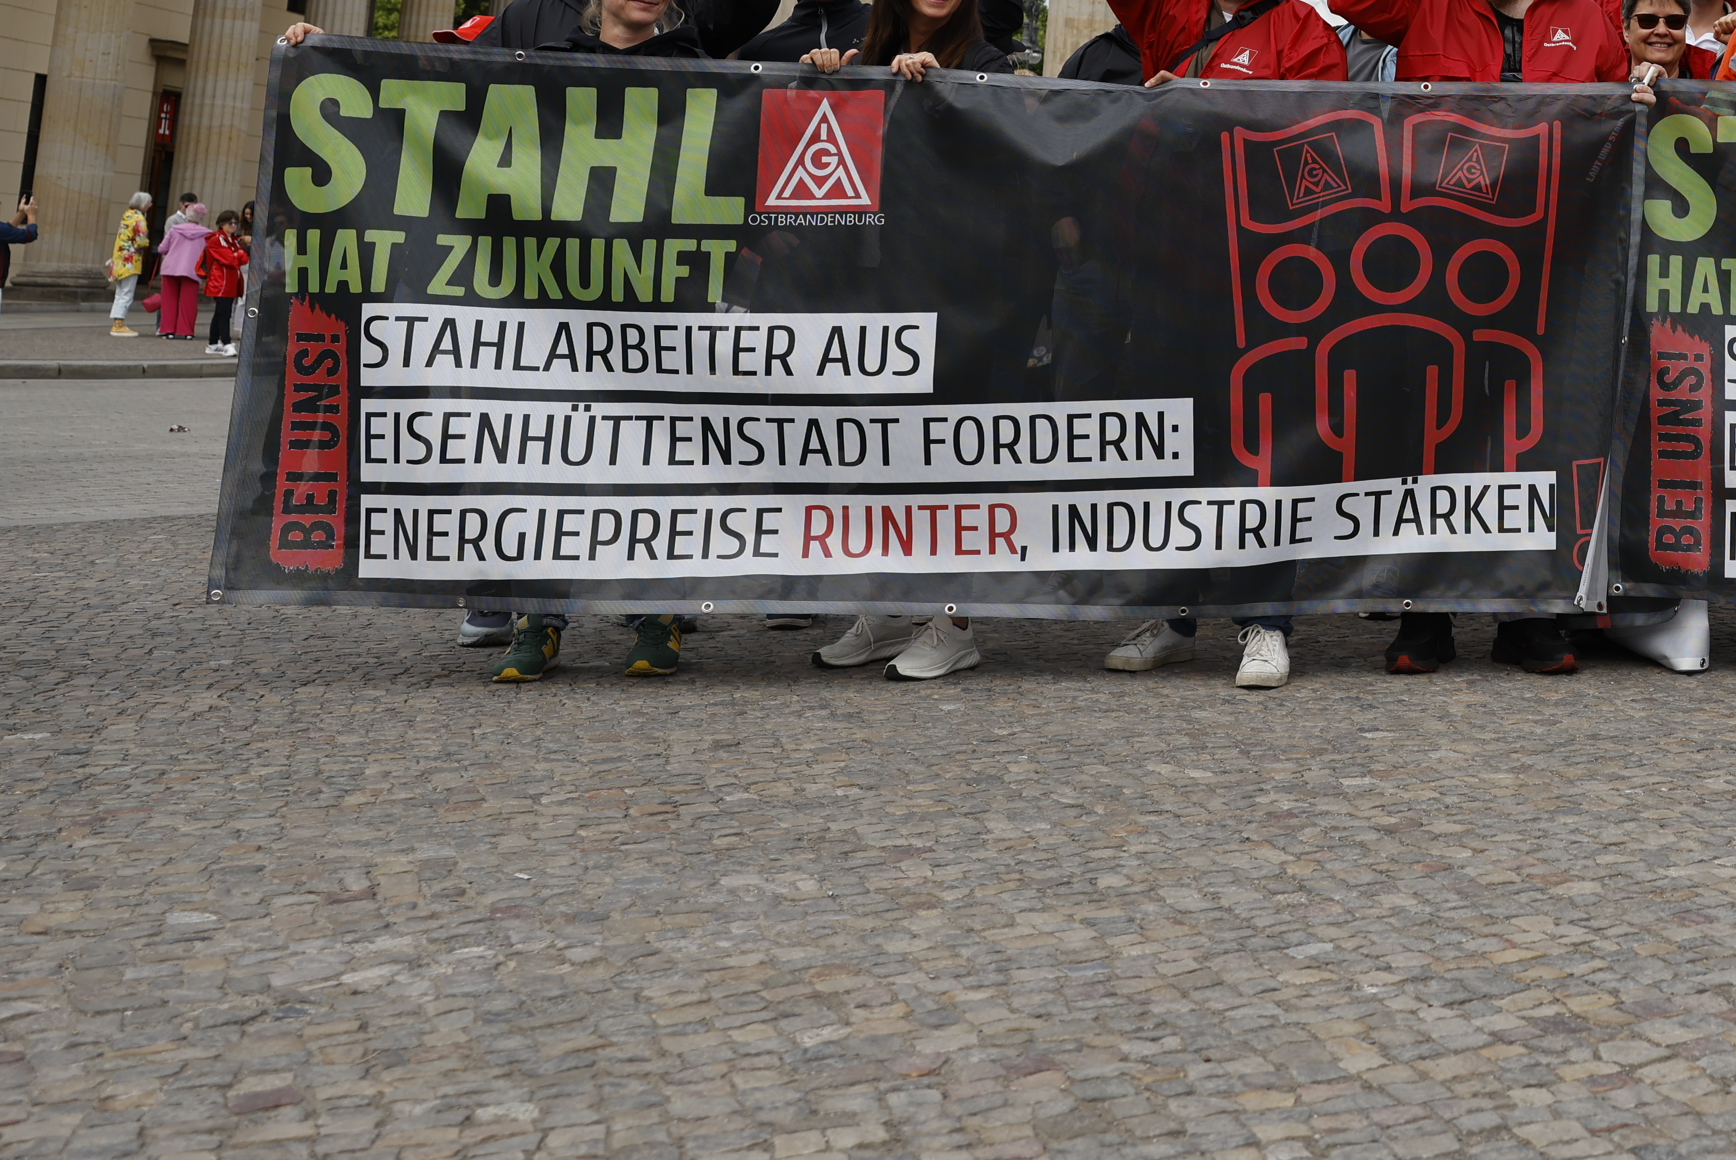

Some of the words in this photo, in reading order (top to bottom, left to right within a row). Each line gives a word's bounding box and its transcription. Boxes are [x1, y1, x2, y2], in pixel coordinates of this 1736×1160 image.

[285, 74, 745, 224] STAHL
[748, 212, 886, 227] OSTBRANDENBURG
[285, 228, 405, 294] HAT
[427, 235, 737, 302] ZUKUNFT
[363, 315, 795, 376] STAHLARBEITER
[816, 325, 921, 377] AUS
[288, 332, 342, 451] UNS!
[1656, 351, 1705, 460] UNS!
[364, 404, 900, 467] EISENHÜTTENSTADT
[922, 411, 1180, 466] FORDERN:
[278, 471, 339, 551] BEI
[364, 507, 782, 562] ENERGIEPREISE
[802, 504, 1028, 562] RUNTER,
[1051, 497, 1315, 553] INDUSTRIE
[1335, 477, 1556, 539] STÄRKEN
[1655, 476, 1704, 554] BEI
